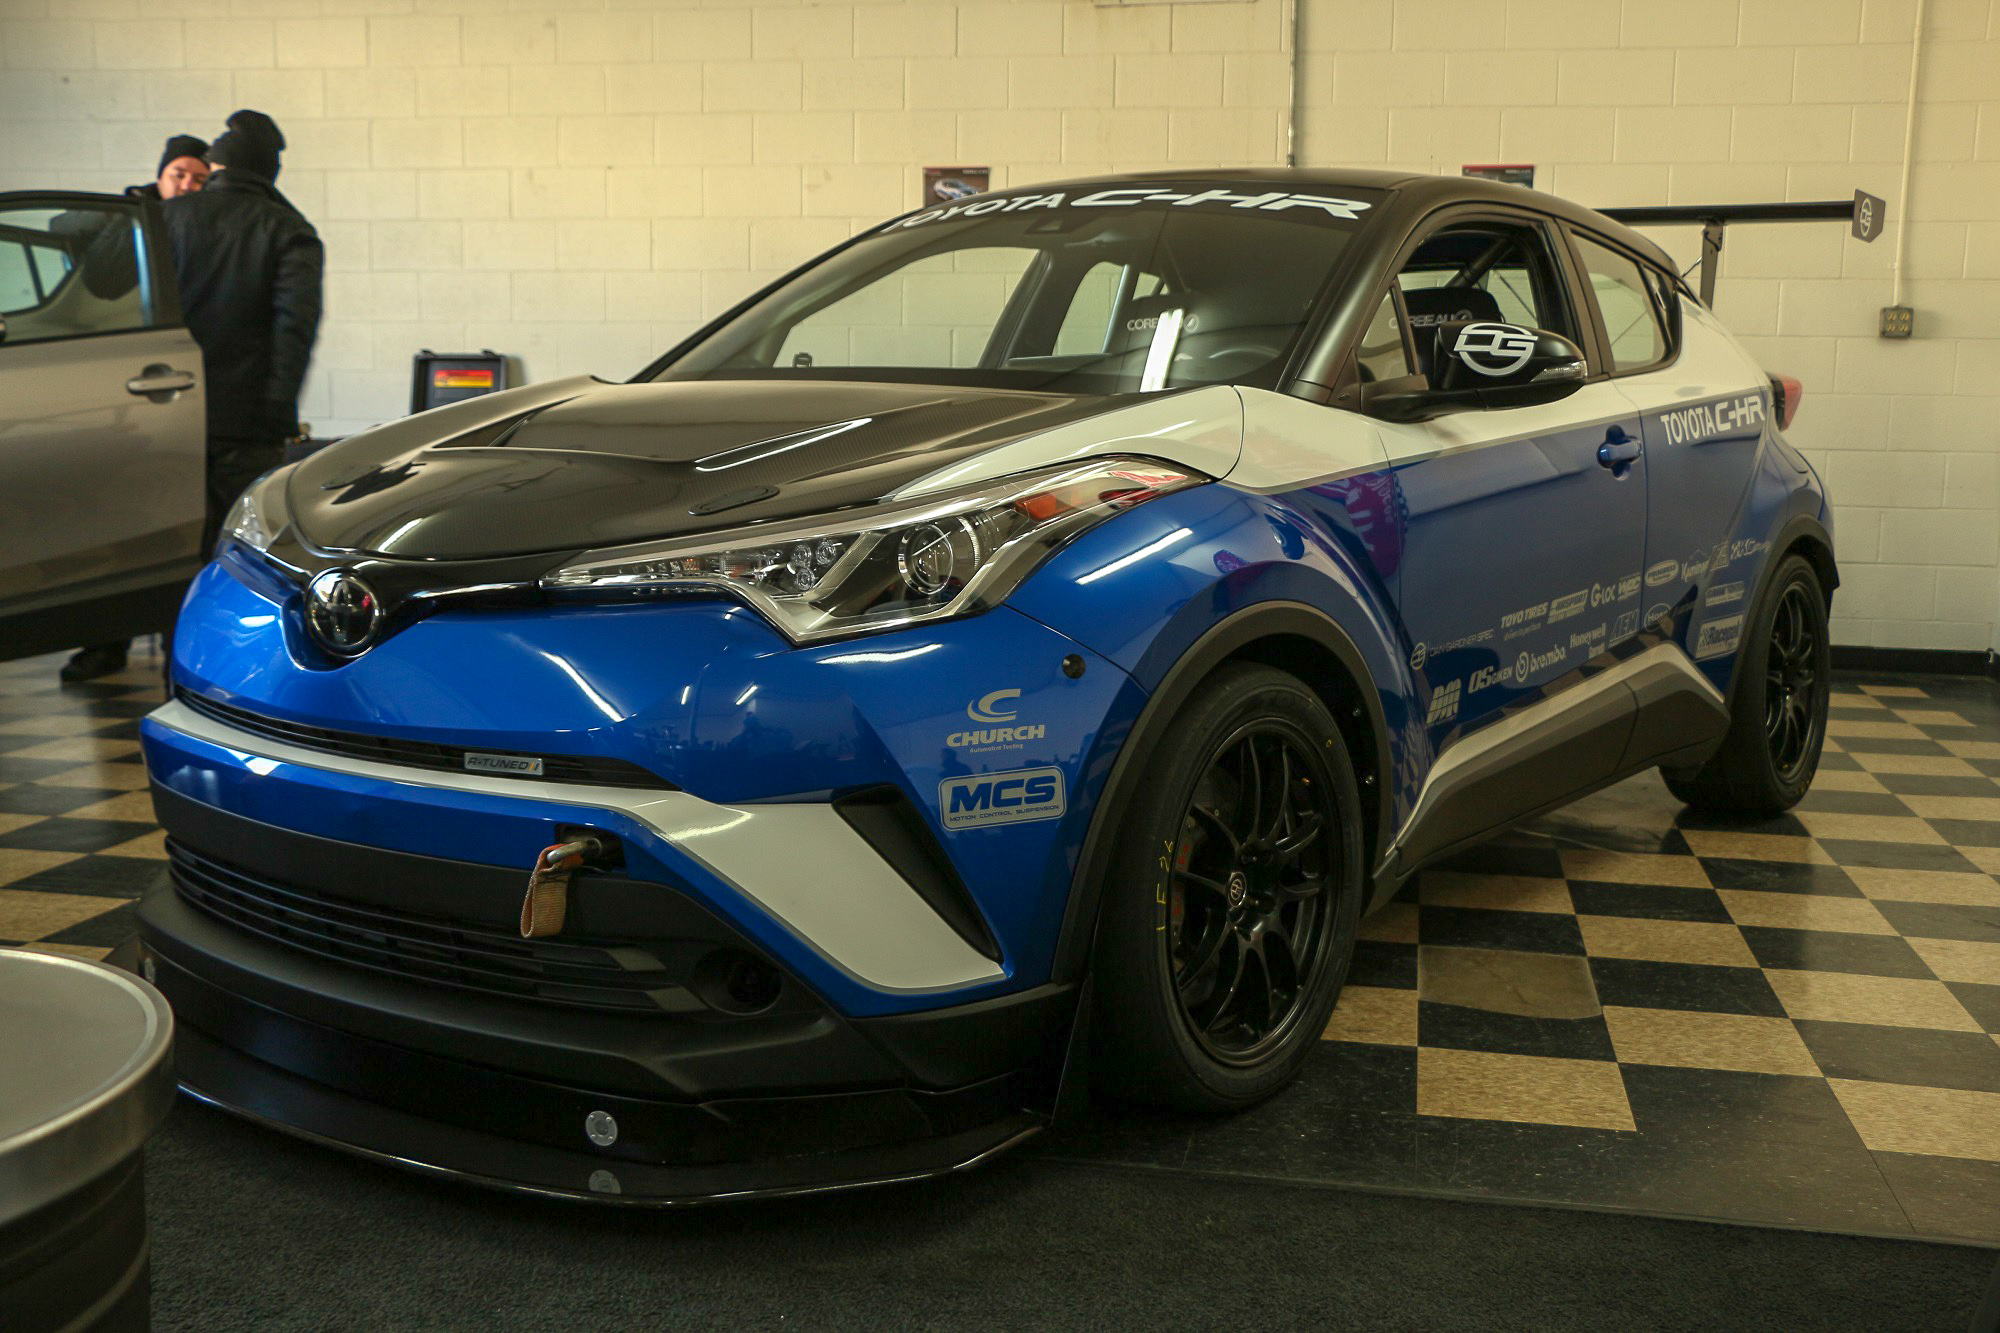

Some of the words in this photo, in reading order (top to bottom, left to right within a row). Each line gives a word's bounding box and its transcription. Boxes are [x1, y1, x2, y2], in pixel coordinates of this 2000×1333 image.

[1070, 189, 1372, 220] C-HR
[1660, 406, 1716, 445] TOYOTA
[1715, 395, 1765, 432] C-HR
[1501, 610, 1523, 629] TOYO
[1524, 602, 1548, 619] TIRES
[1477, 629, 1494, 642] SPEC
[1570, 622, 1607, 648] Honeywell
[1529, 644, 1567, 673] brembo
[946, 724, 1045, 747] CHURCH
[468, 757, 529, 770] R-TUNED
[949, 775, 1057, 813] MCS
[979, 811, 1013, 819] CONTROL
[1015, 805, 1059, 815] SUSPENSION
